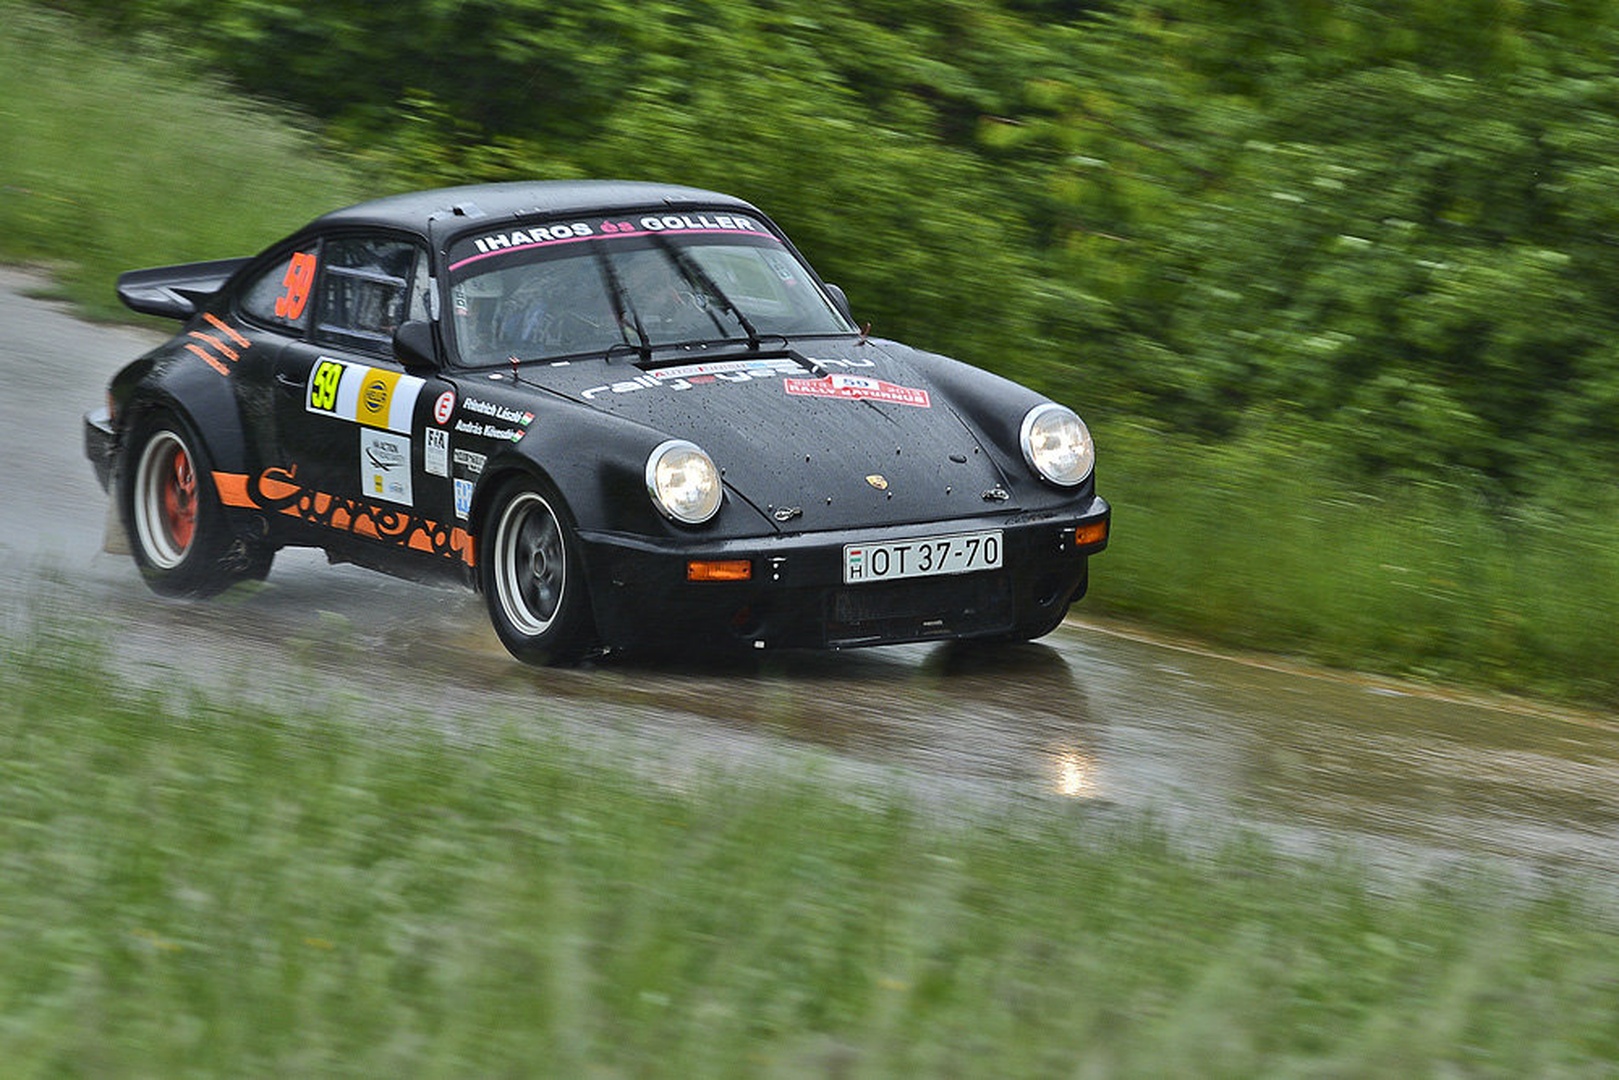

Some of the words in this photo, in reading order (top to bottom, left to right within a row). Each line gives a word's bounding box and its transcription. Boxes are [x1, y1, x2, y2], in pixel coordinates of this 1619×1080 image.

[473, 222, 593, 253] IHAROS
[600, 220, 635, 233] és
[641, 215, 755, 232] GOLLER
[275, 252, 317, 320] 59
[311, 361, 342, 410] 59
[789, 385, 835, 395] RALLY
[843, 378, 869, 388] 59
[437, 396, 450, 417] E
[246, 463, 469, 562] Carrera
[850, 564, 863, 579] H
[871, 546, 912, 576] OT
[918, 536, 999, 572] 37-70
